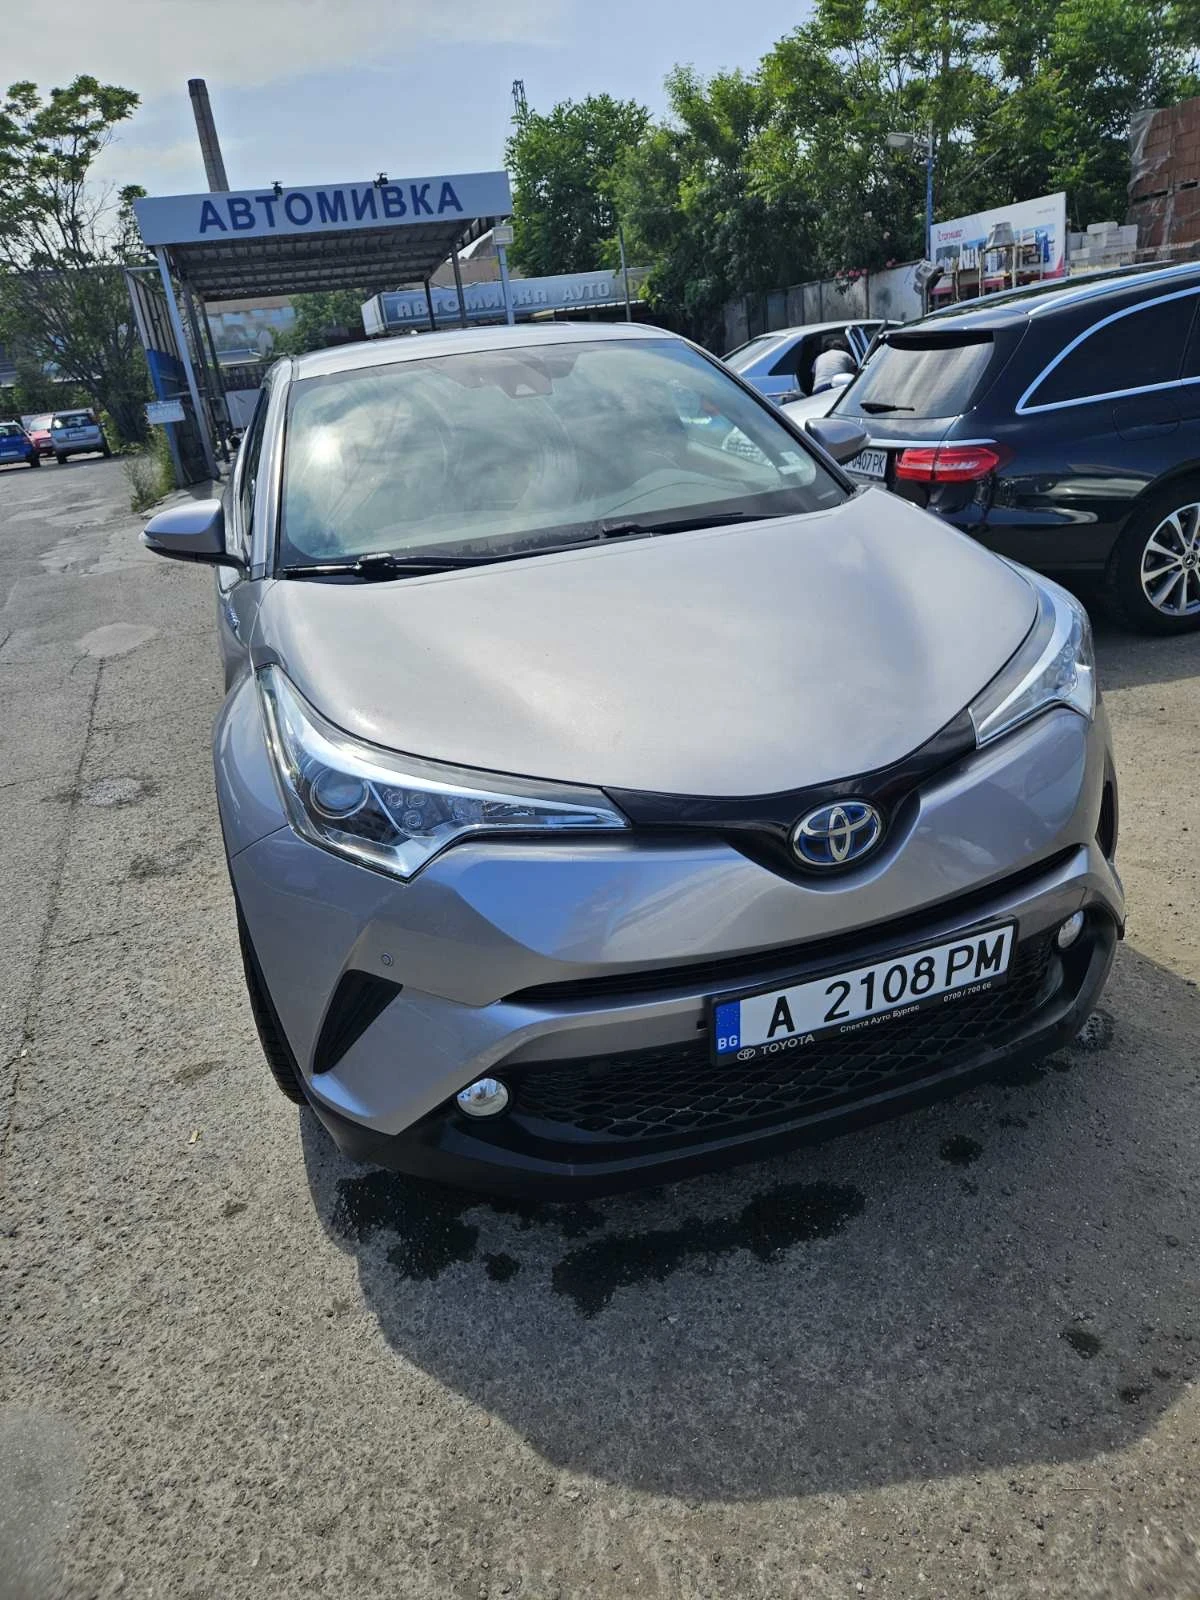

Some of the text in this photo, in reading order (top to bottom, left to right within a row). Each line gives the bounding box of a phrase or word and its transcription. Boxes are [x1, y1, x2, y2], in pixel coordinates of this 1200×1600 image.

[199, 181, 464, 233] АВТОМИВКА
[562, 281, 610, 302] АУТО
[766, 995, 796, 1039] A
[870, 1013, 892, 1025] Ауто
[717, 1035, 738, 1051] BG
[761, 1033, 815, 1055] TOYOTA
